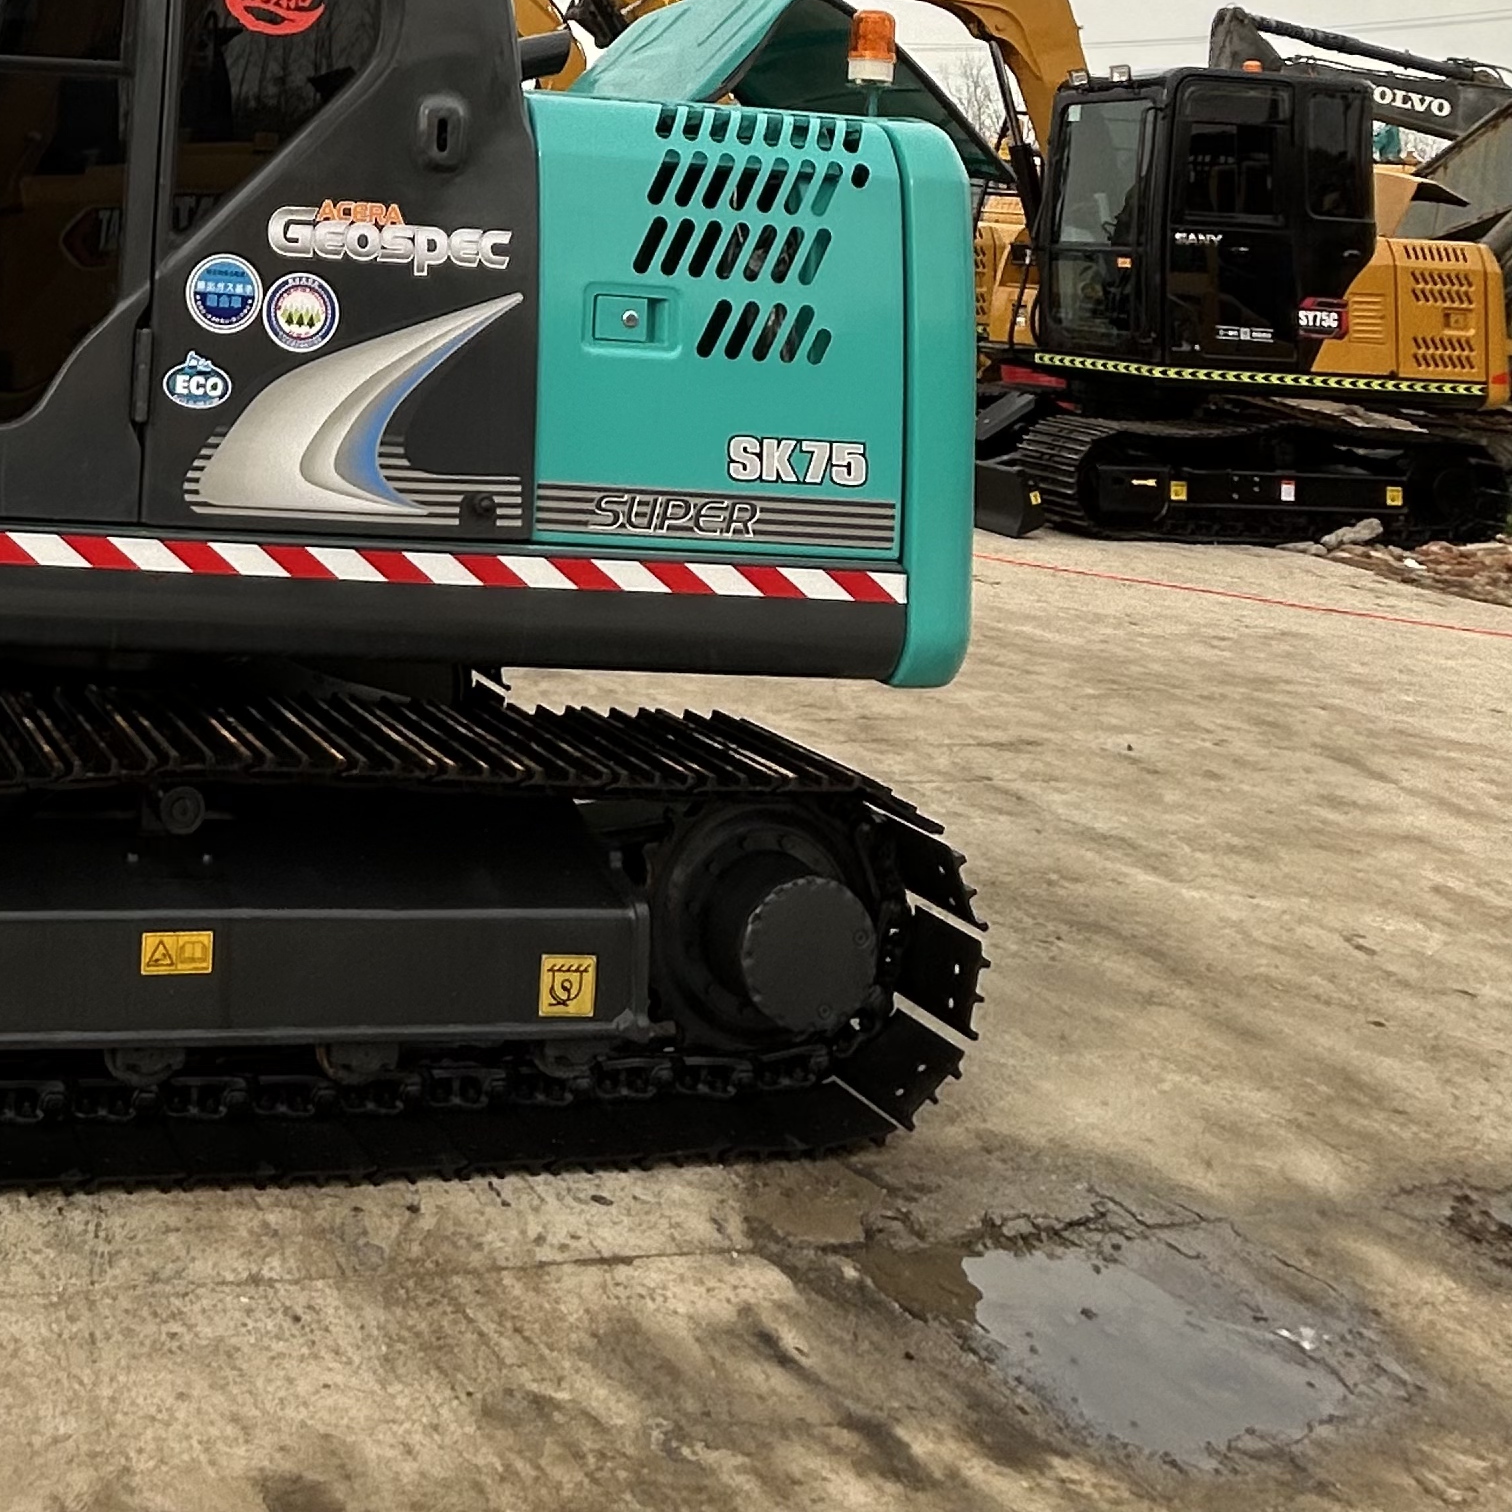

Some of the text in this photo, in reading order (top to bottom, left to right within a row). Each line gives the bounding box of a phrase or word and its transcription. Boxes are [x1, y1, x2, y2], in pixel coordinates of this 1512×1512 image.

[1373, 86, 1451, 117] OLVO
[316, 199, 405, 226] ACERA
[1174, 232, 1224, 246] SANY
[1298, 310, 1339, 328] SY75C
[175, 374, 224, 397] ECO
[727, 434, 869, 488] SK75
[589, 493, 760, 538] SUPER
